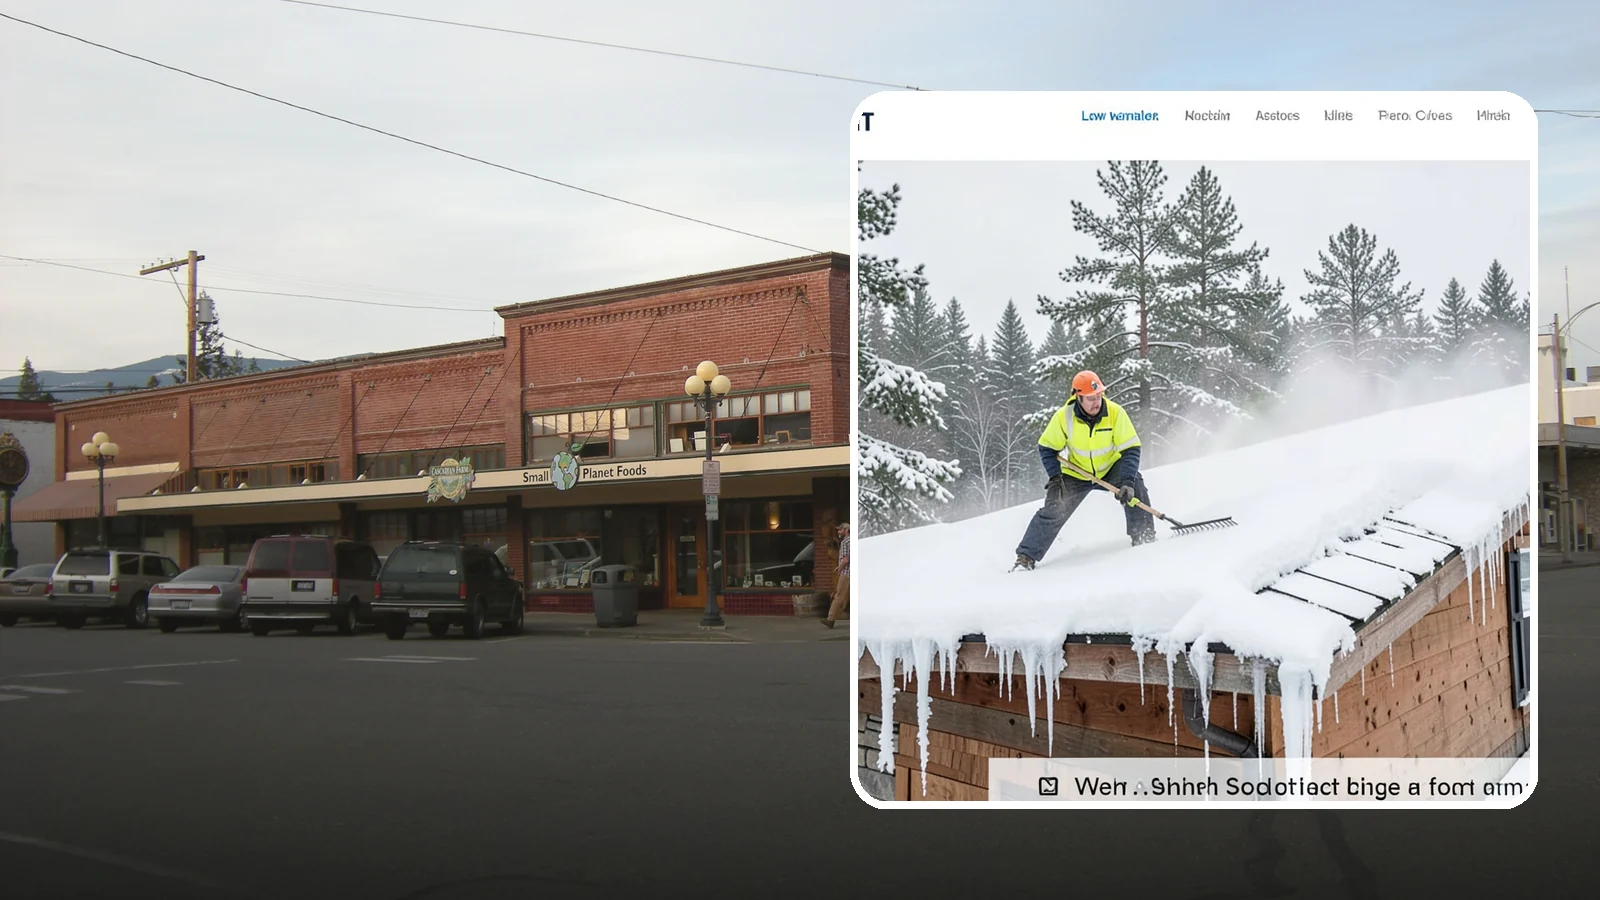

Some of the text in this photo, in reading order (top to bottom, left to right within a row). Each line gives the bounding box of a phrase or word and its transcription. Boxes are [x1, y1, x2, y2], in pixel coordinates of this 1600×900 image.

[523, 464, 647, 483] Small Planet Foods
